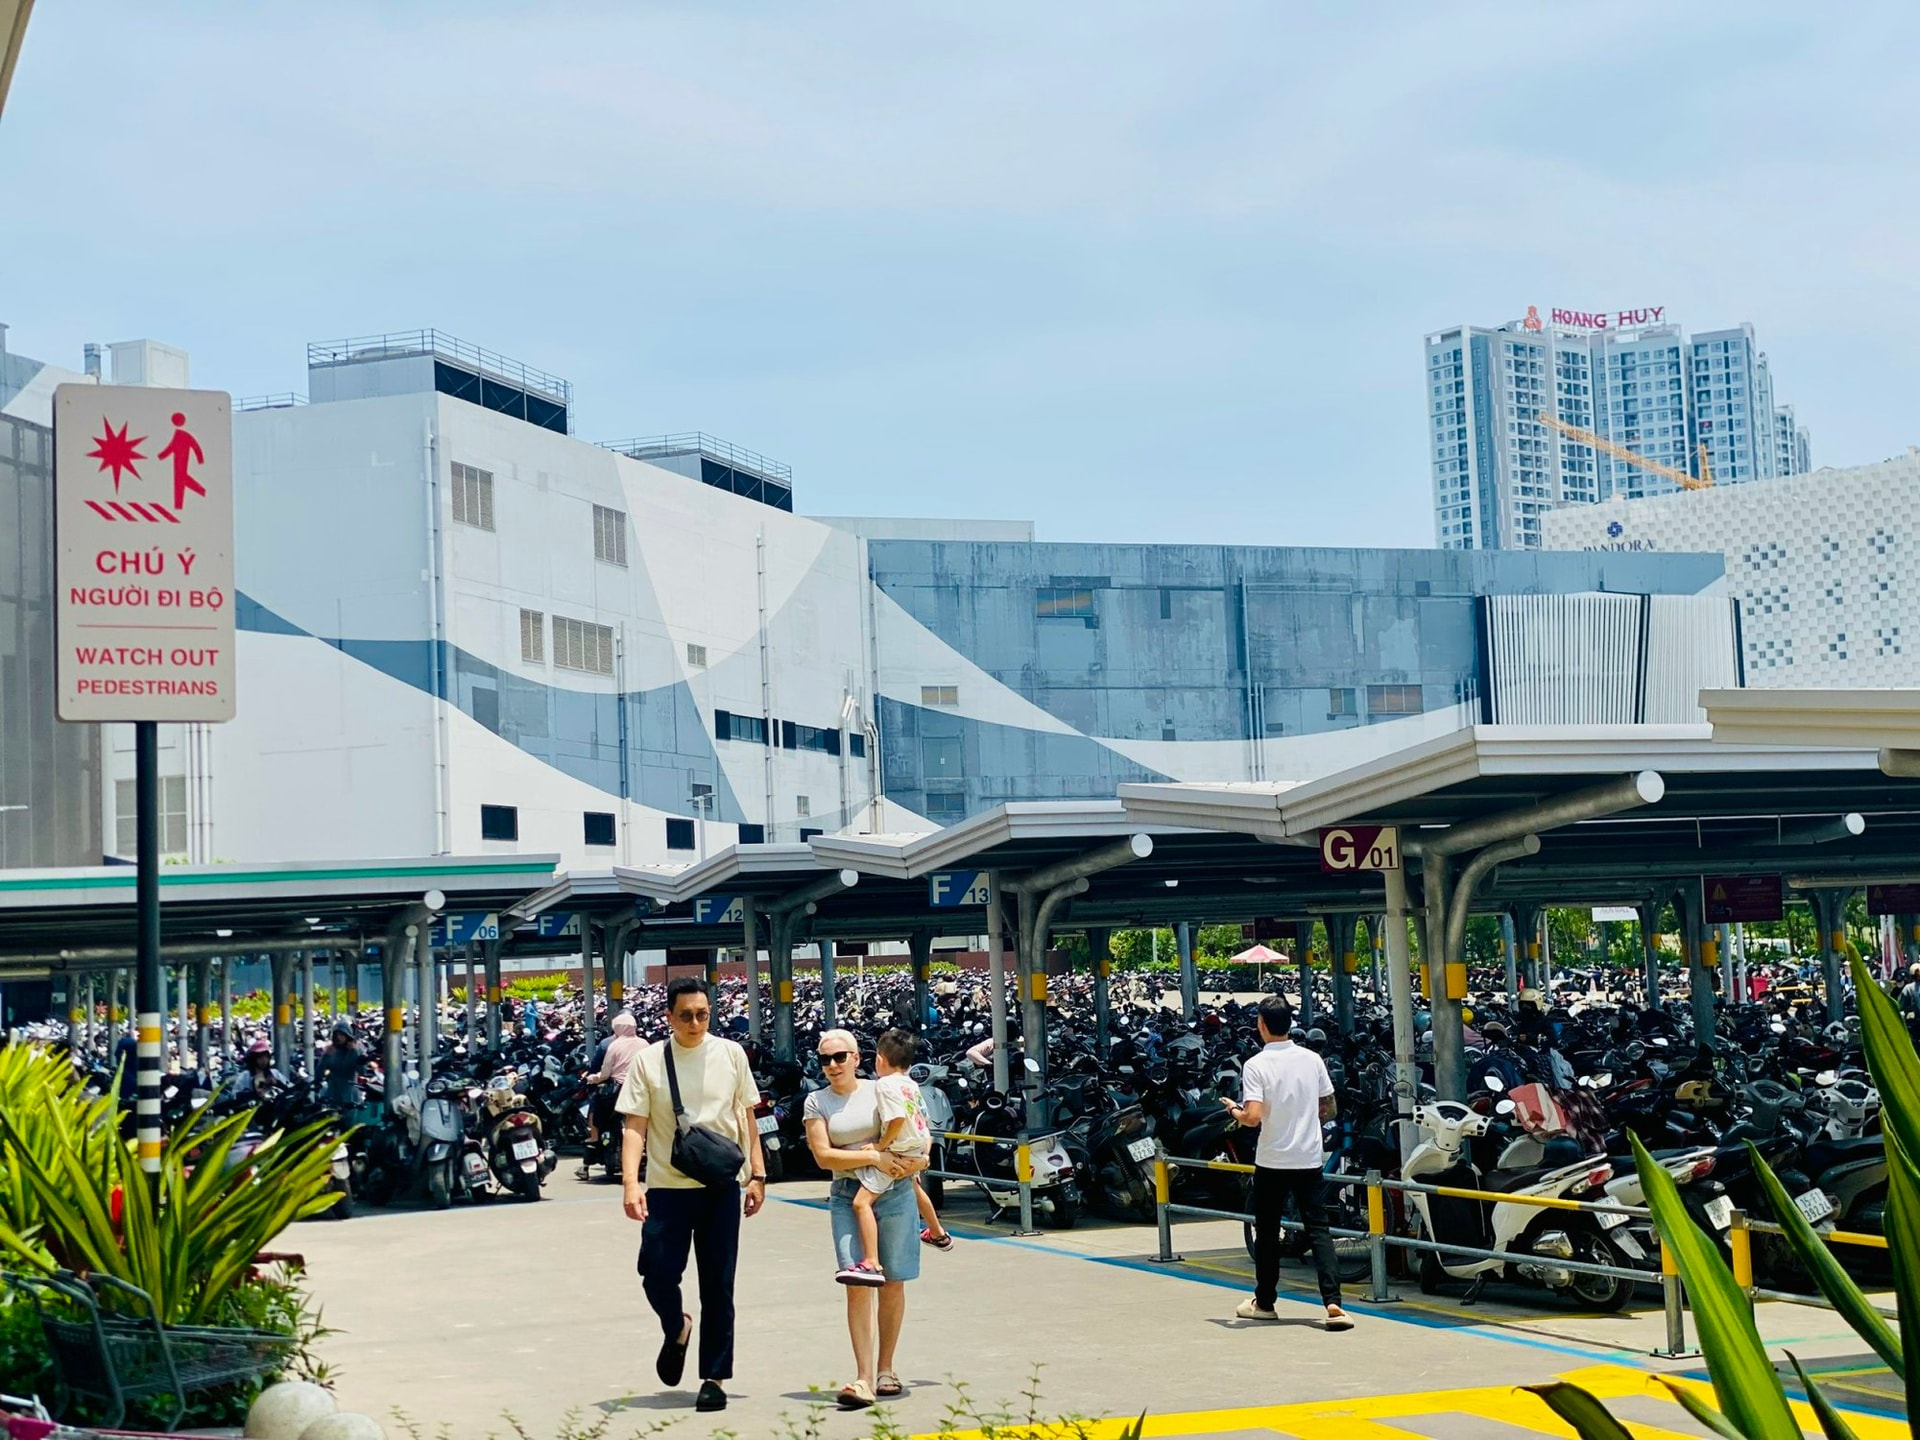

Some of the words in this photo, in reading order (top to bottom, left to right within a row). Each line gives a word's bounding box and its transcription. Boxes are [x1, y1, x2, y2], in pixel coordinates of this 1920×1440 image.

[1552, 307, 1607, 328] HOANG
[1618, 306, 1664, 326] HUY
[95, 546, 164, 575] CHÚ
[177, 547, 196, 575] Ý
[70, 584, 149, 606] NGƯỜI
[157, 589, 181, 607] ĐI
[189, 586, 223, 612] BỘ
[75, 647, 163, 665] WATCH
[170, 648, 219, 666] OUT
[76, 679, 218, 695] PEDESTRIANS
[1323, 829, 1356, 869] G
[1370, 846, 1394, 867] 01
[932, 875, 952, 904] F
[968, 887, 989, 903] 13
[695, 899, 712, 922] F
[726, 909, 743, 922] 12
[446, 915, 464, 940] F
[478, 926, 497, 939] 06
[540, 915, 554, 935] F
[565, 923, 578, 935] 11
